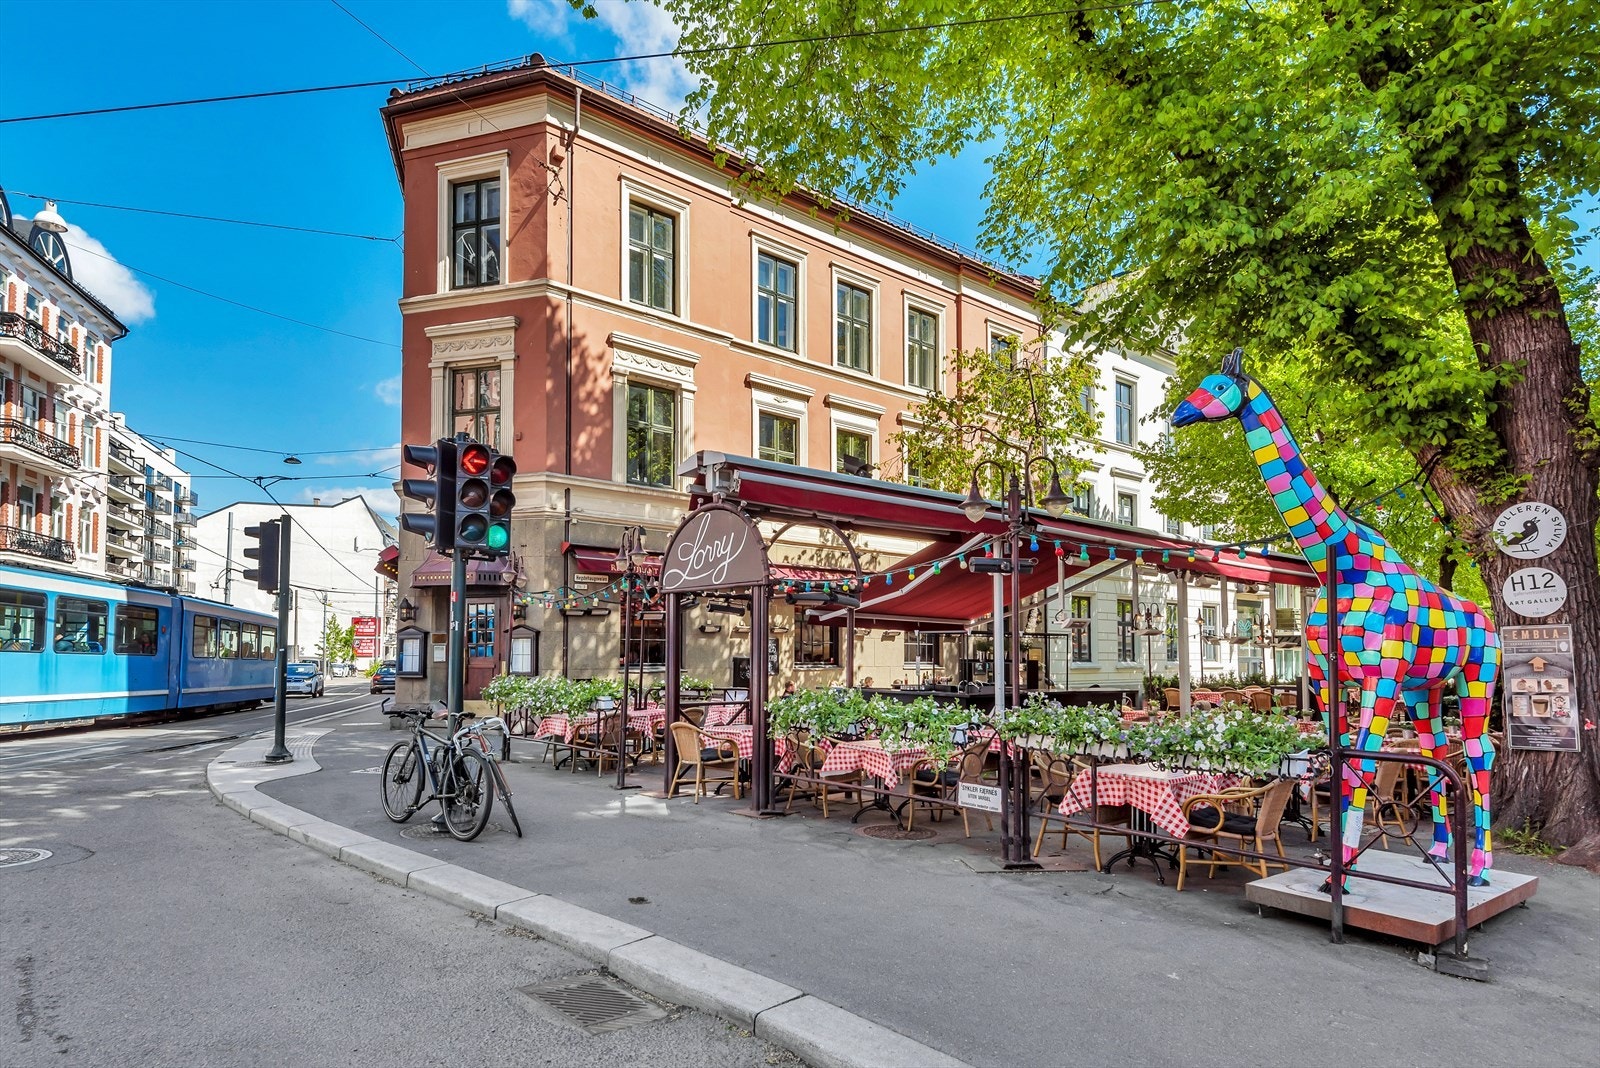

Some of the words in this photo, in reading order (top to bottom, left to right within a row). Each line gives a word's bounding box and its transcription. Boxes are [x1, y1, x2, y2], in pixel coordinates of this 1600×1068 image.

[1545, 516, 1562, 548] SYLVIA
[663, 512, 748, 589] Lorry
[1511, 572, 1556, 591] H12
[1527, 597, 1565, 605] GALLERY
[1512, 629, 1559, 640] EMBLA
[961, 784, 978, 792] SYKLER
